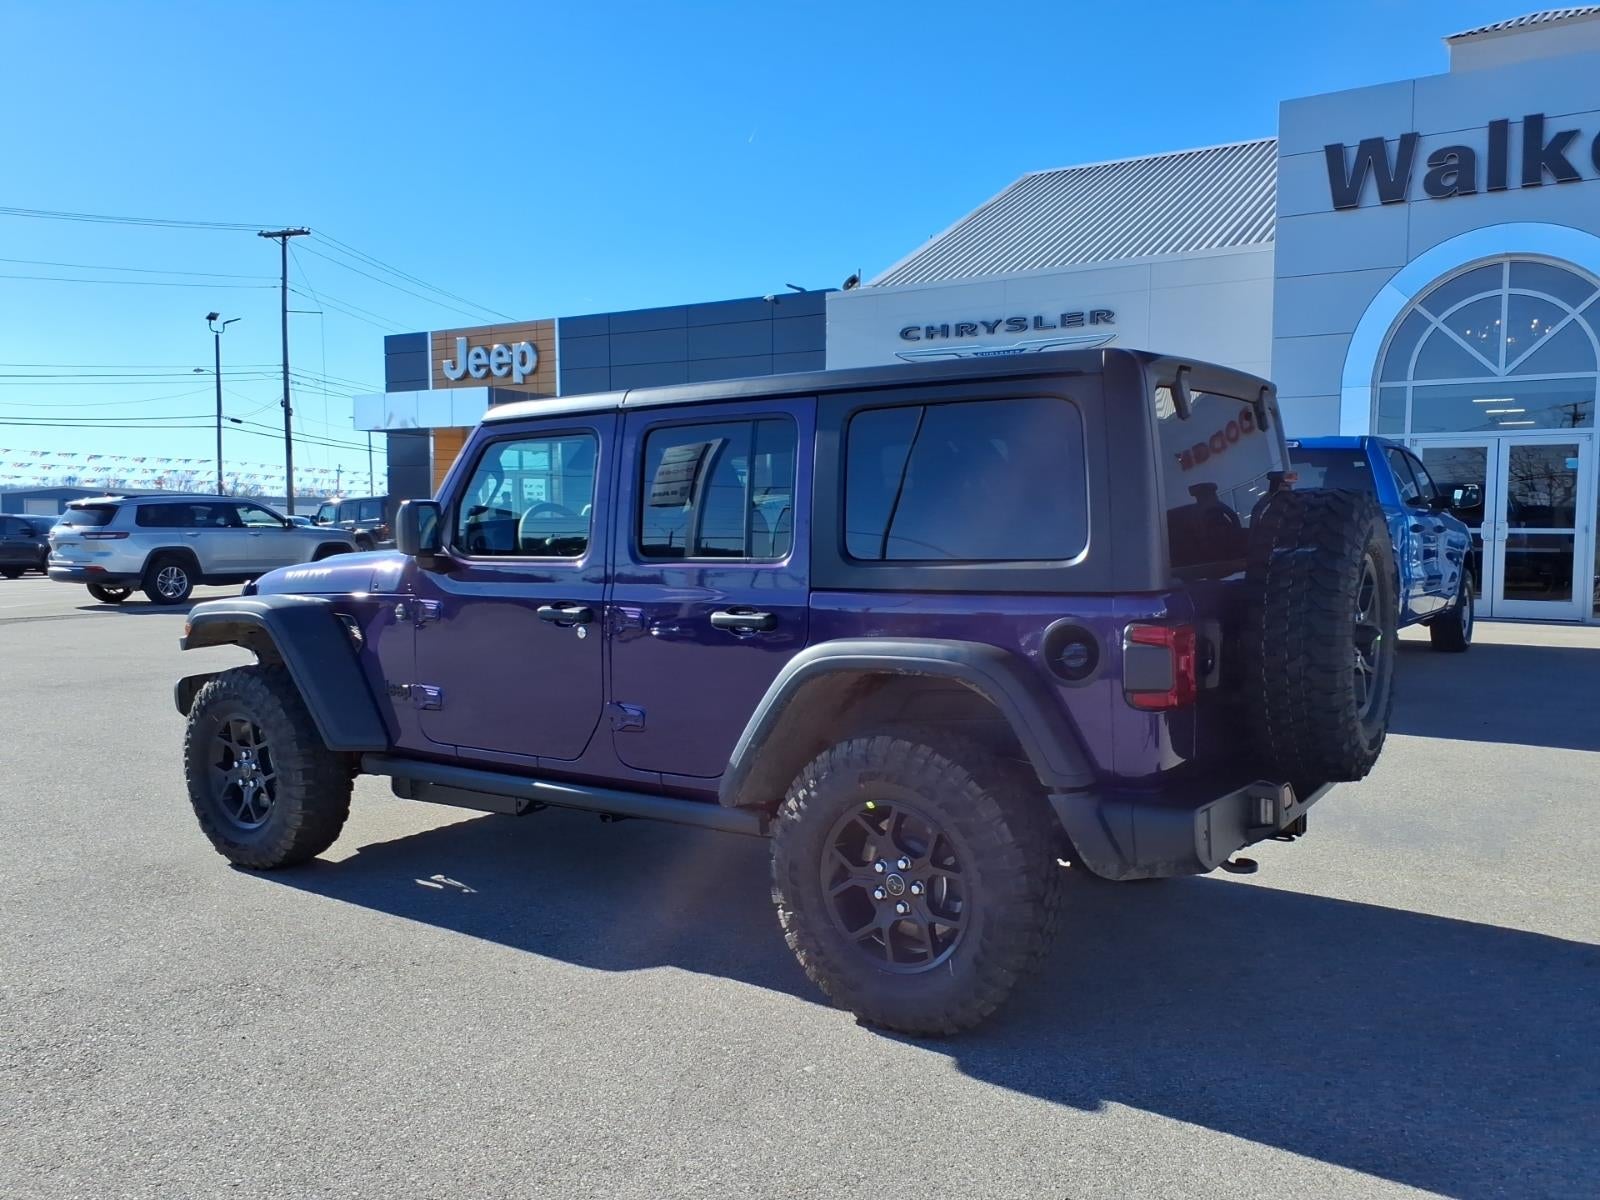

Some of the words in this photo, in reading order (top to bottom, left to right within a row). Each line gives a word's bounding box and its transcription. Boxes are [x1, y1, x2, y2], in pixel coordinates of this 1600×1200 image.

[1324, 113, 1600, 211] Walk
[899, 308, 1116, 342] CHRYSLER
[442, 336, 538, 385] Jeep
